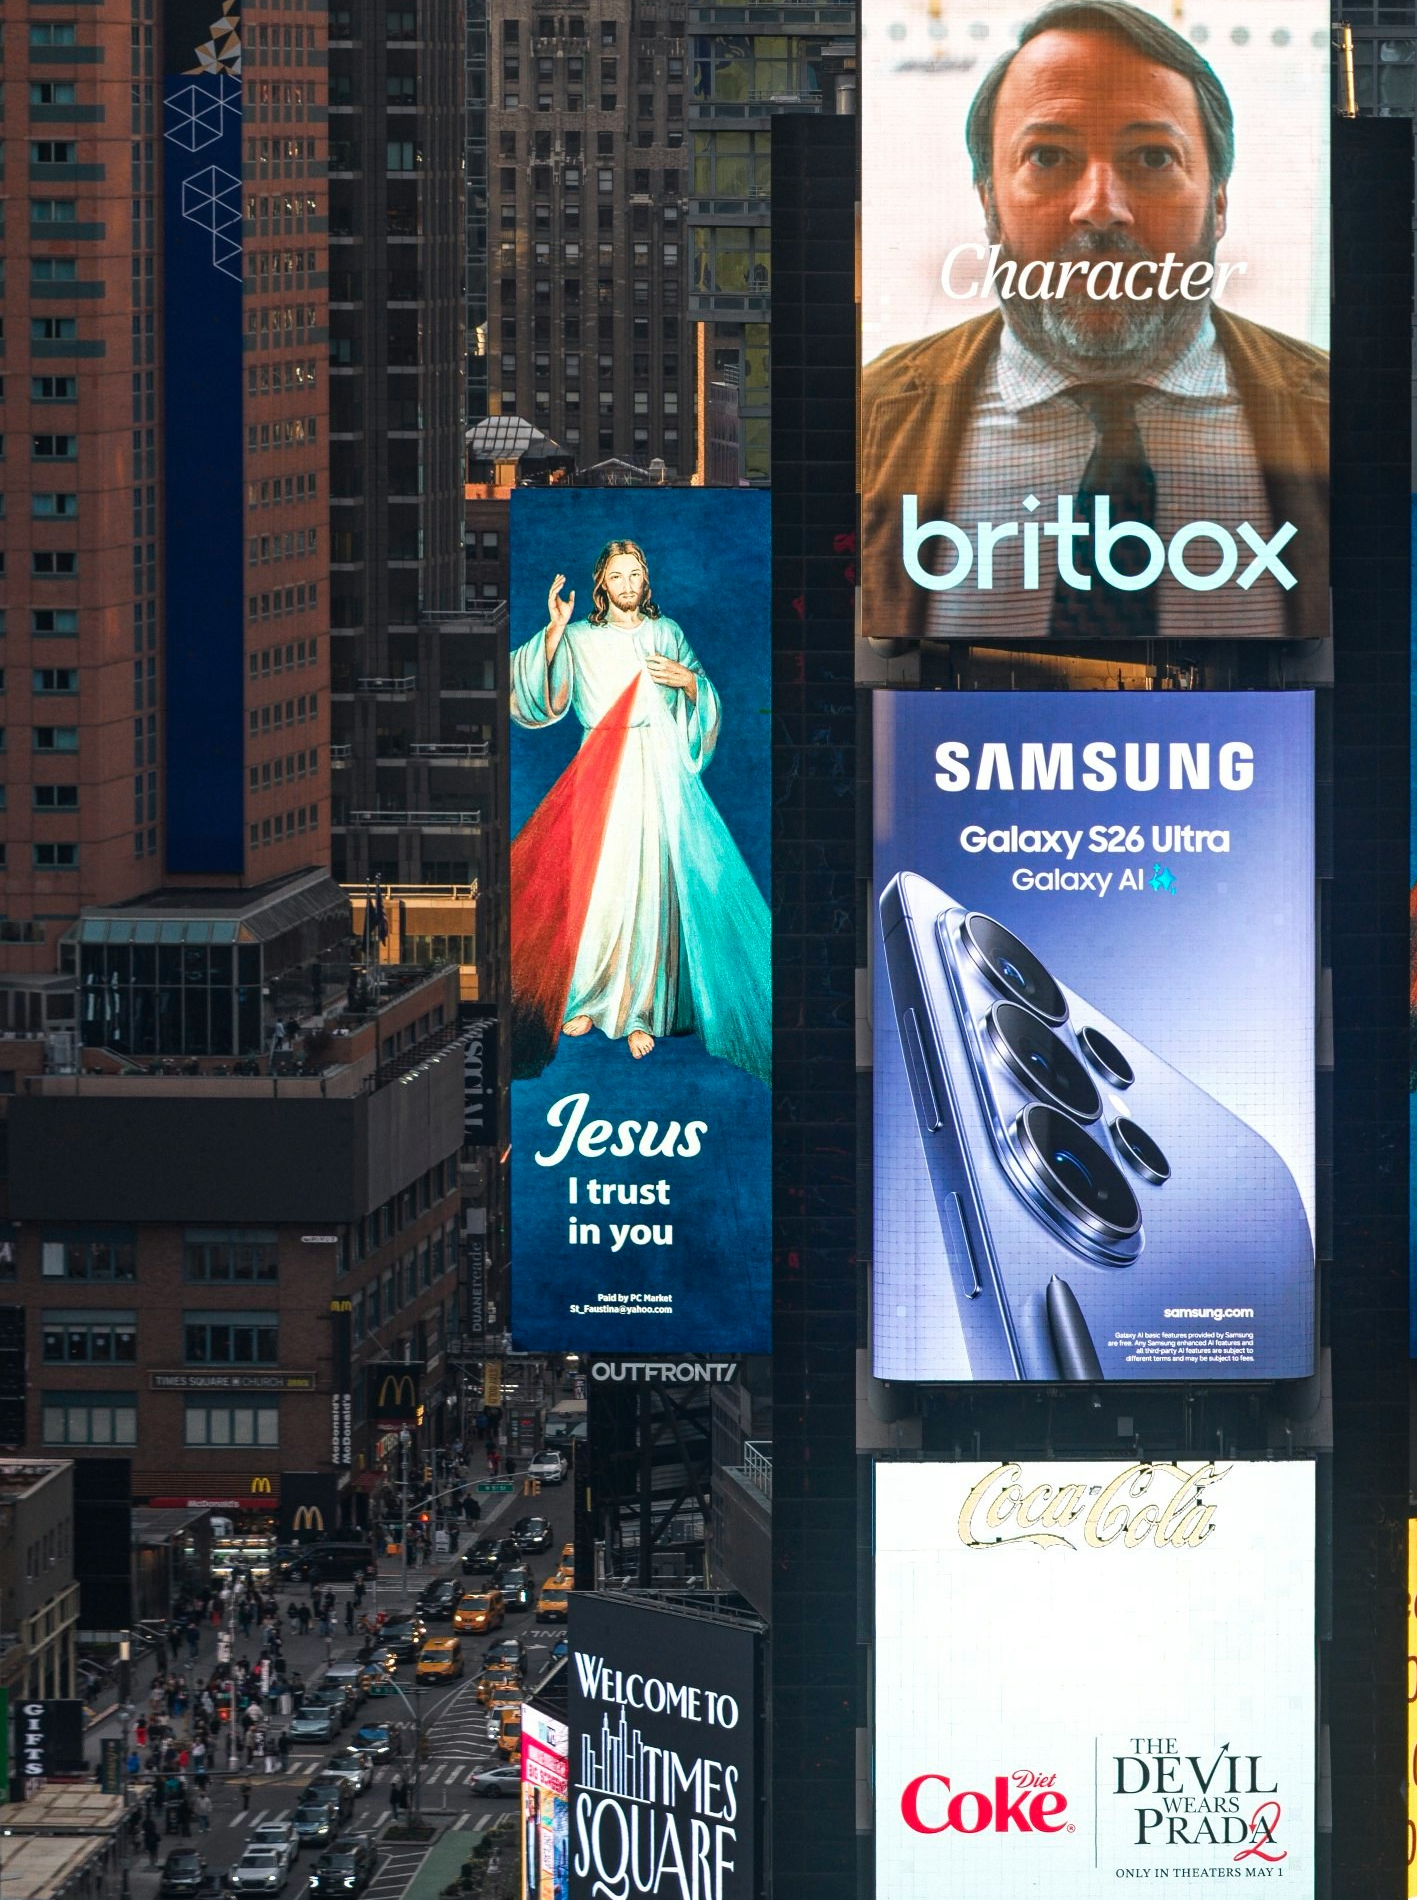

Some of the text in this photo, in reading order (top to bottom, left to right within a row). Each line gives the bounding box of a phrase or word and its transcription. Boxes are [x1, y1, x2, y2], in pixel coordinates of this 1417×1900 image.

[940, 243, 1246, 301] Character
[902, 494, 1298, 592] britbox
[935, 741, 1254, 792] SAMSUNG
[960, 825, 1230, 860] Galaxy S26 Ultra
[1012, 868, 1144, 896] Galaxy AI
[535, 1093, 708, 1167] Jesus
[569, 1177, 671, 1205] I trust
[569, 1216, 673, 1253] in you
[598, 1293, 673, 1305] Paid by PC Market
[1164, 1308, 1254, 1320] samsung.com
[1216, 1332, 1224, 1340] by
[155, 1377, 187, 1386] TIMES
[189, 1377, 231, 1386] SQUARE
[242, 1377, 284, 1386] CHURCH
[187, 1500, 239, 1508] McDonald's
[574, 1651, 739, 1729] WELCOME TO
[22, 1704, 45, 1775] GIFTS
[1130, 1738, 1178, 1754] THE
[643, 1745, 738, 1822] TIMES
[1011, 1770, 1057, 1790] Diet
[1113, 1747, 1278, 1794] DEVIL
[900, 1773, 1069, 1835] Coke
[1162, 1796, 1240, 1813] WEARS
[1134, 1801, 1287, 1862] PRADA 2
[1116, 1867, 1283, 1878] ONLY IN THEATERS MAY 1
